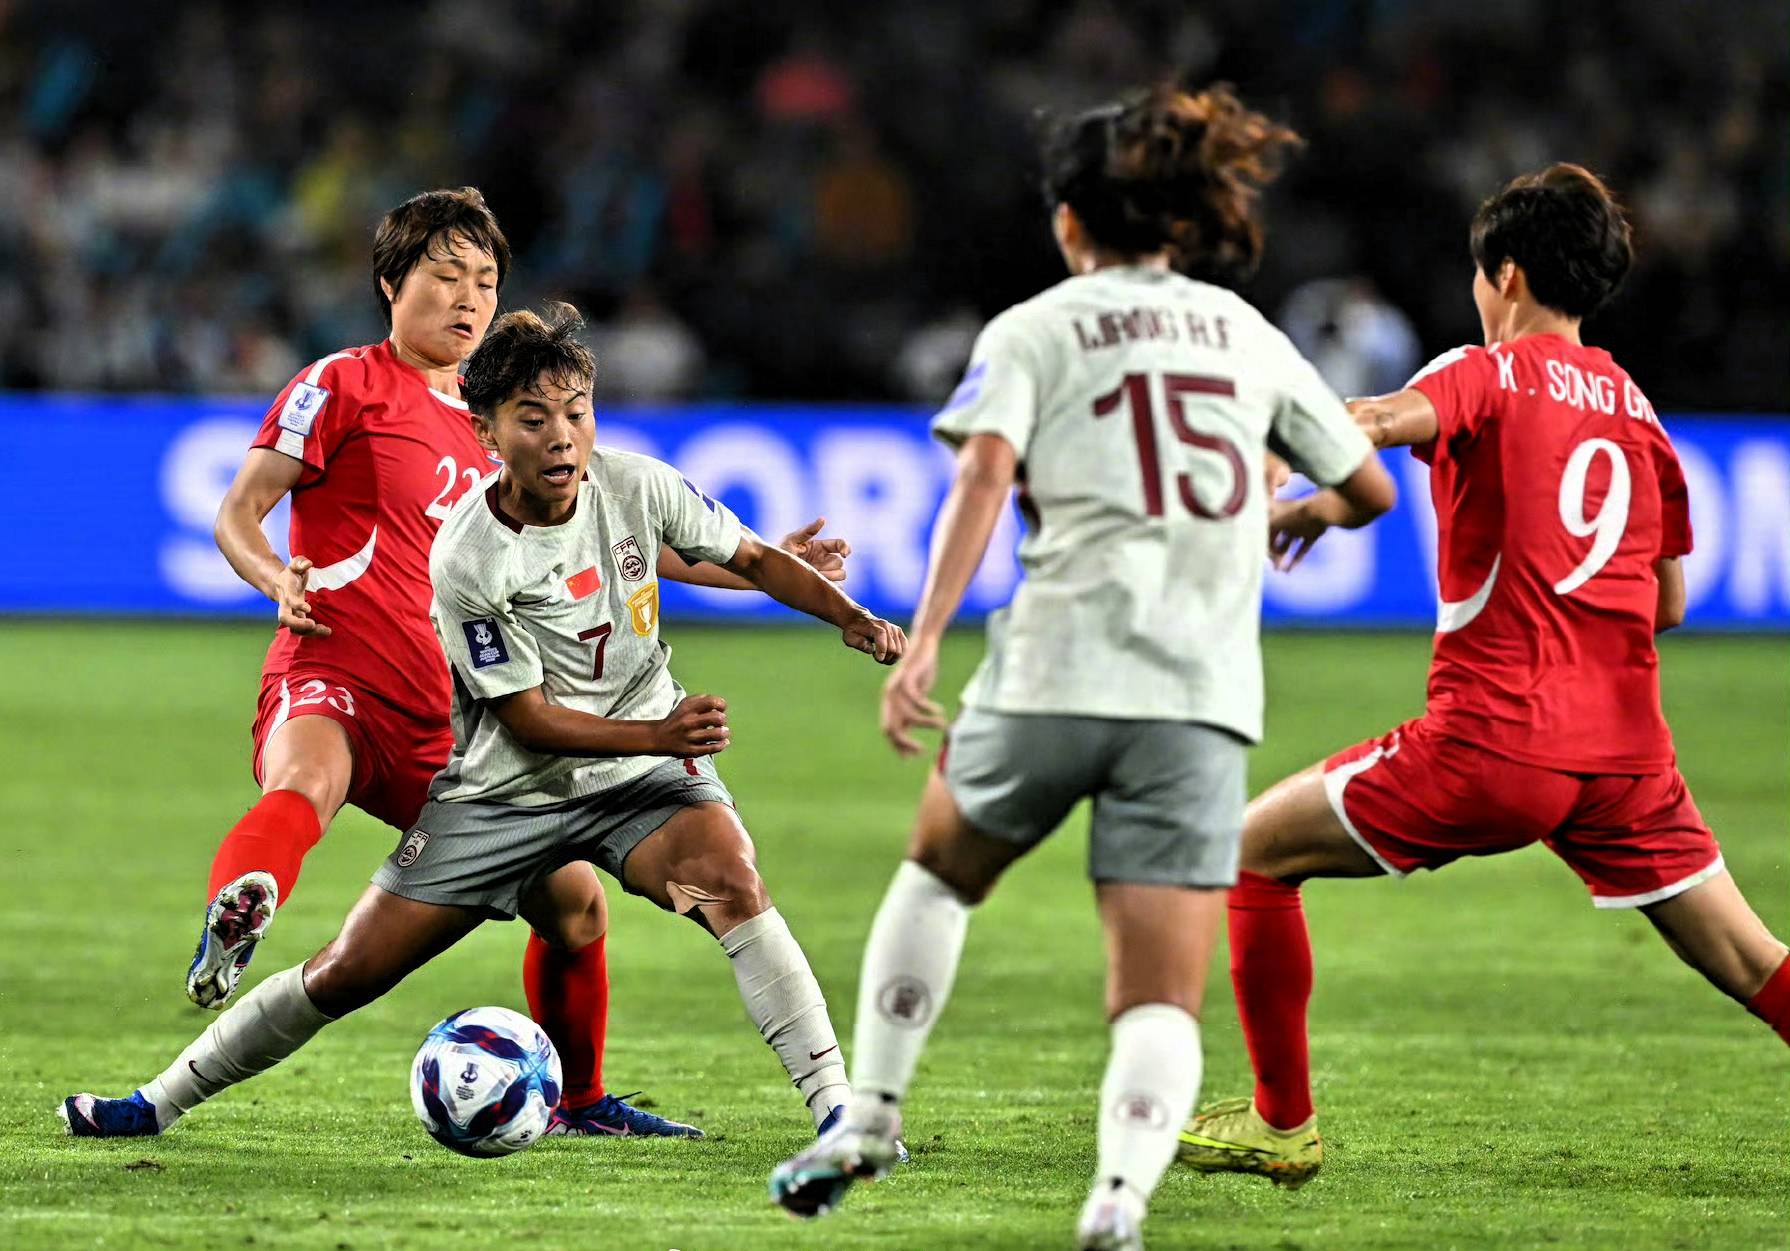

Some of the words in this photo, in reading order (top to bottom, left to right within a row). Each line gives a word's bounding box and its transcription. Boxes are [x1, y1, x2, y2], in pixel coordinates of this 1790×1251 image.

[1546, 359, 1615, 415] SONG
[1092, 371, 1248, 520] 15
[1554, 437, 1632, 595] 9
[577, 621, 612, 681] 7
[290, 679, 355, 717] 23
